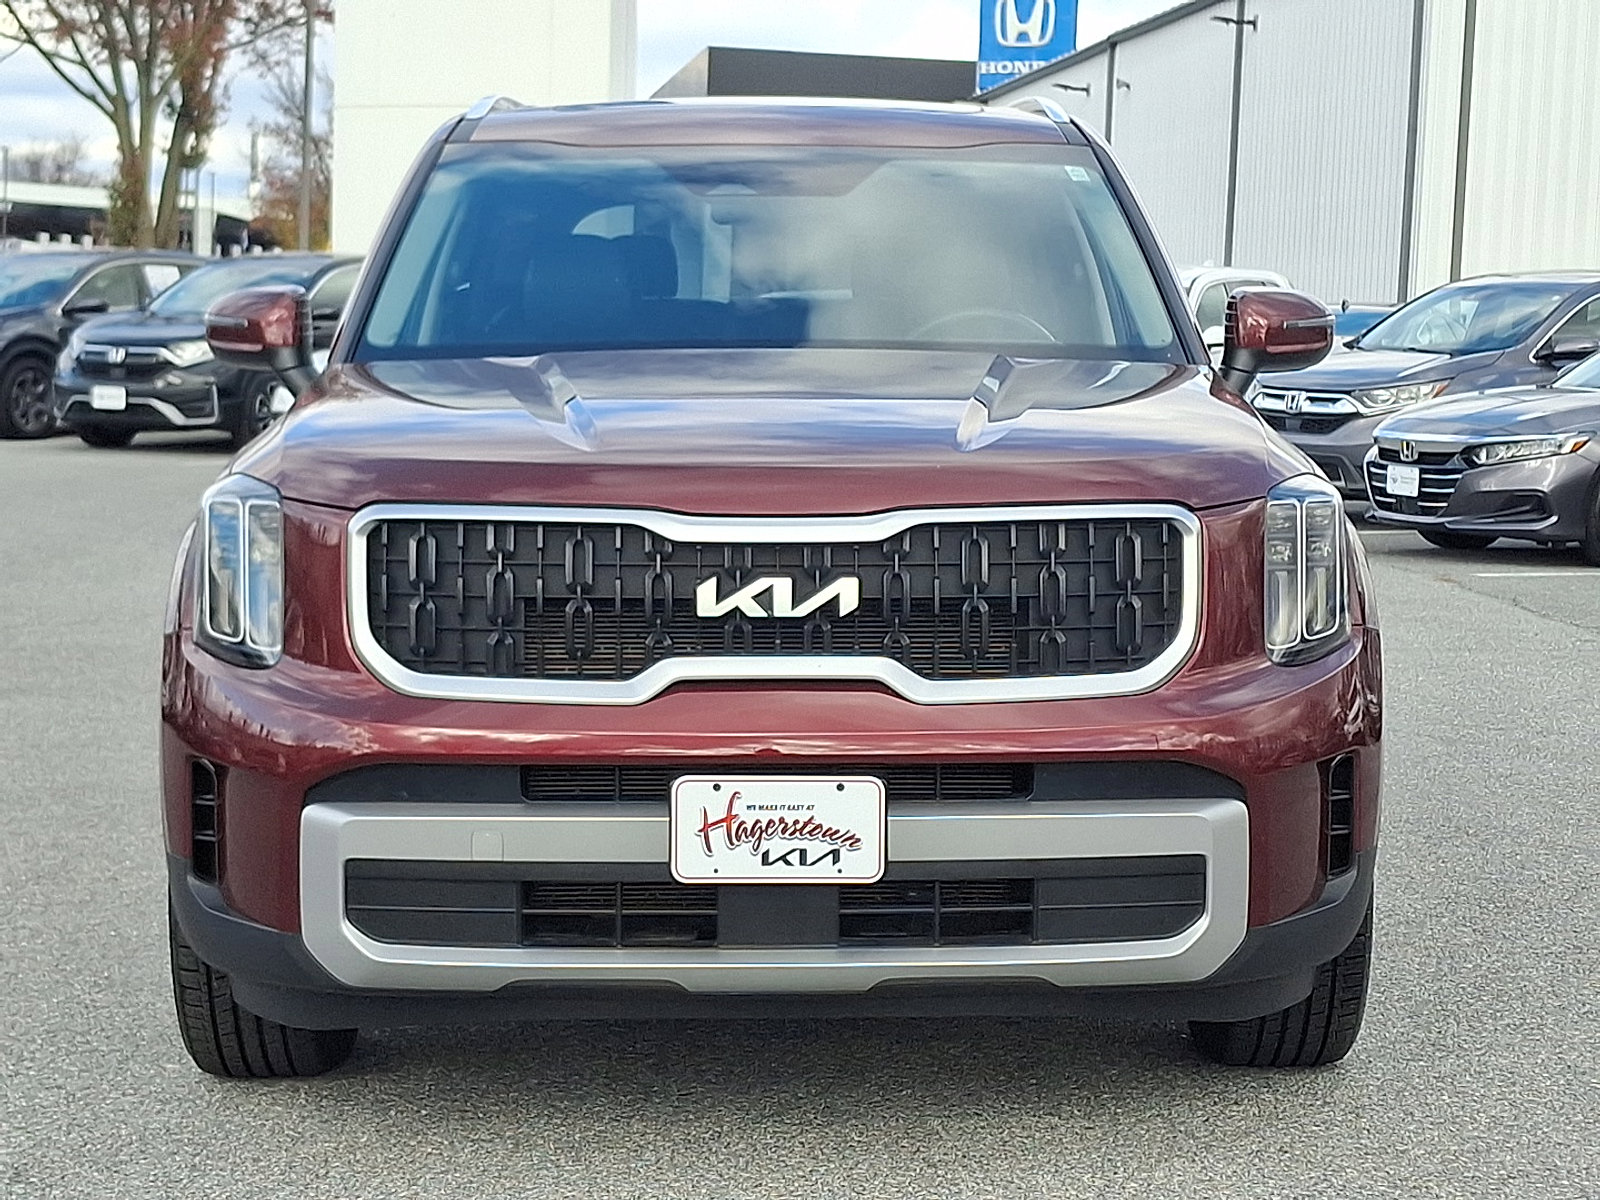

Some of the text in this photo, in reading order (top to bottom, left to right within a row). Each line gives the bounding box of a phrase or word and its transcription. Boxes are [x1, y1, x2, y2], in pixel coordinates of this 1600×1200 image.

[696, 576, 859, 617] KIA
[697, 791, 863, 854] Hagerstown
[761, 848, 841, 866] KIA
